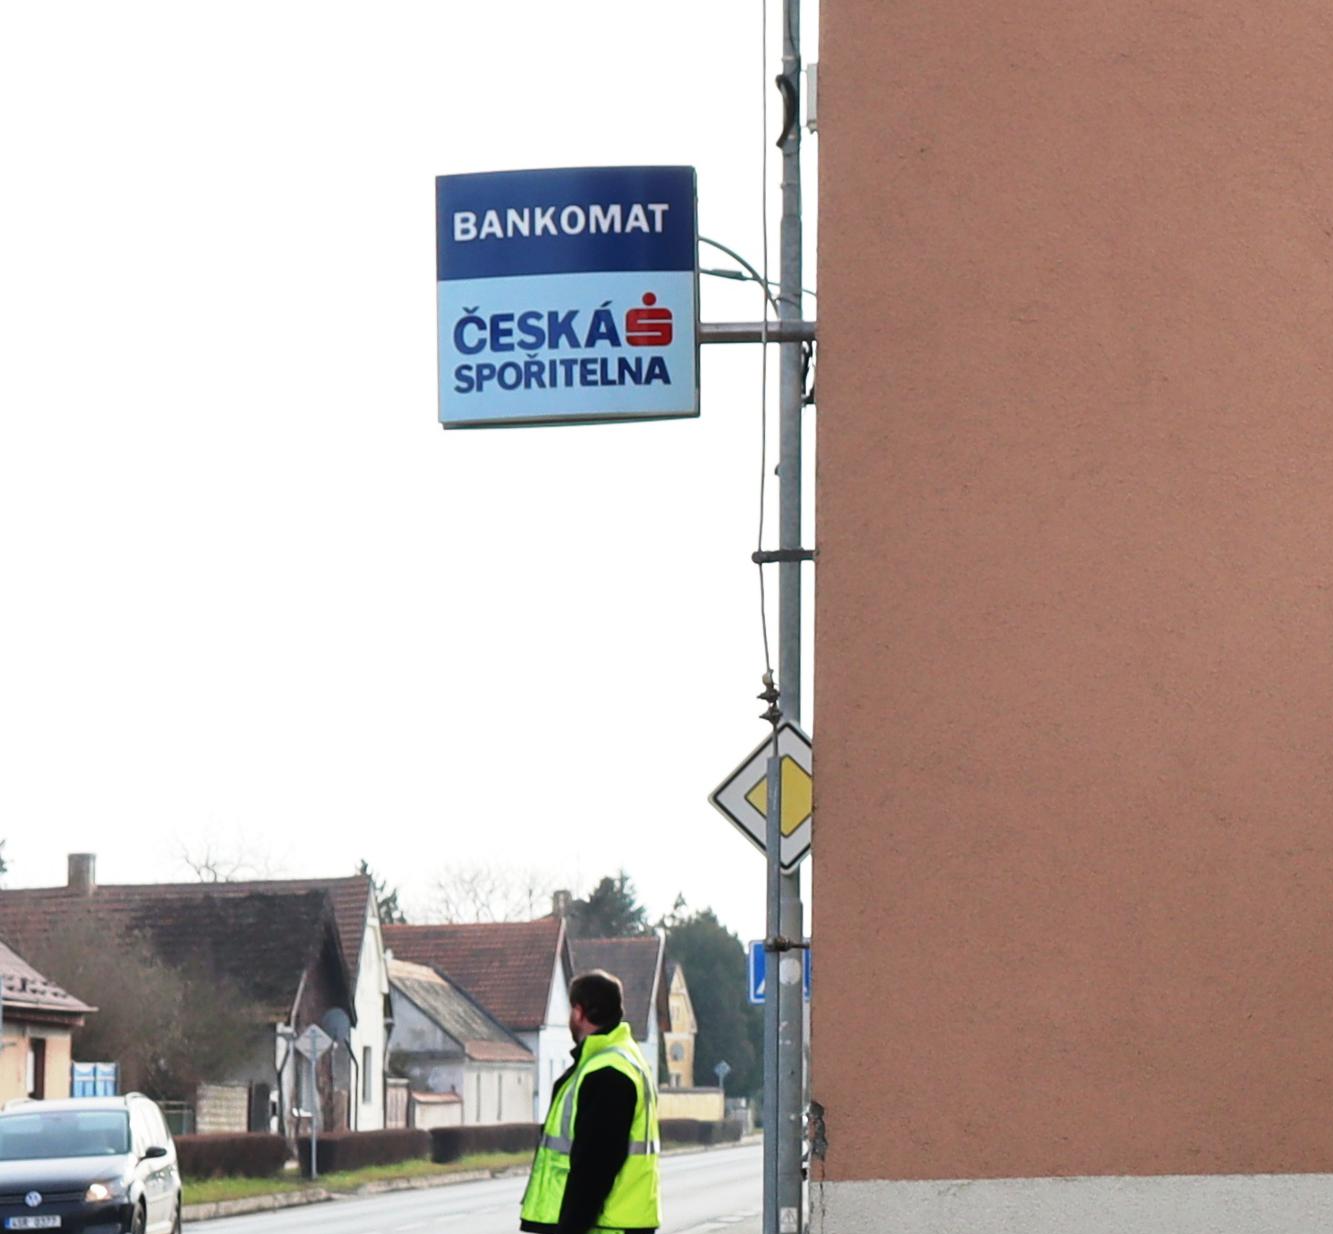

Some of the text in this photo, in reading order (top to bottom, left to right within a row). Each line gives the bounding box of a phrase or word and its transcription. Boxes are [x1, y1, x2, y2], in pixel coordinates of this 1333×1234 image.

[453, 203, 669, 242] BANKOMAT
[454, 301, 622, 355] ČESKÁ
[454, 353, 671, 394] SPOŘITELNA
